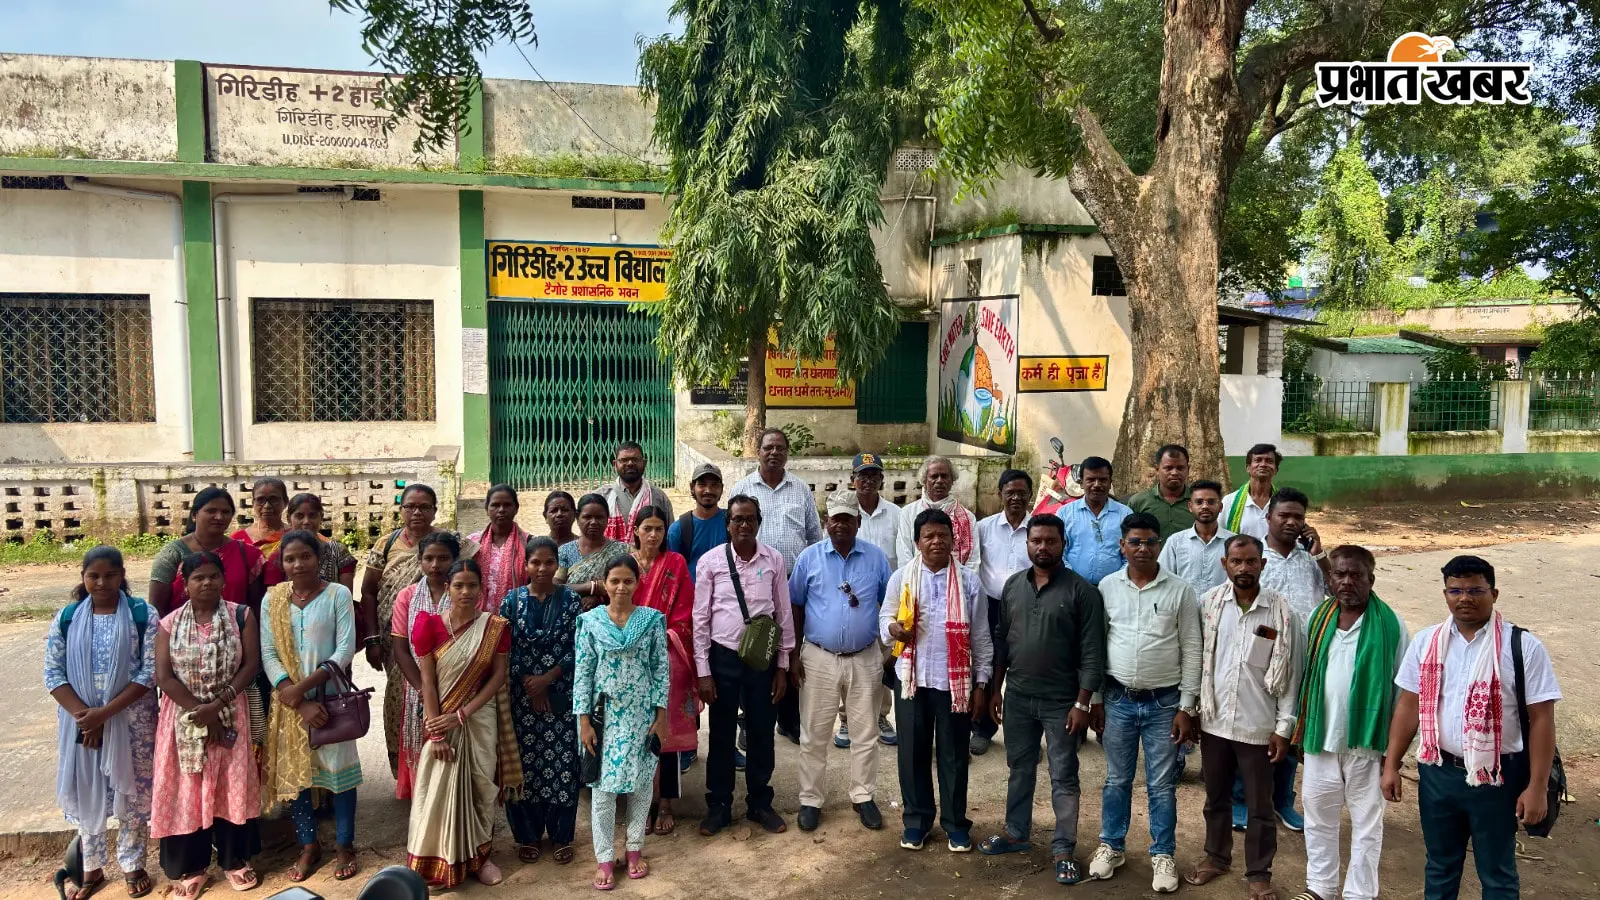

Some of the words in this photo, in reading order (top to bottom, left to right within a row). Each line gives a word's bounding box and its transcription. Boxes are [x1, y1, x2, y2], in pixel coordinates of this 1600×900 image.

[215, 73, 300, 102] गिरिडीह
[309, 84, 344, 103] +2
[614, 250, 673, 284] विद्याल
[544, 282, 568, 298] टैगोर
[571, 284, 614, 298] प्रशासनिक
[618, 287, 641, 299] भवन
[981, 306, 996, 335] SAVE
[994, 317, 1016, 364] EARTH
[1021, 363, 1044, 381] कर्म
[1047, 362, 1061, 381] ही
[1066, 366, 1090, 385] पूजा
[765, 625, 776, 660] sports
